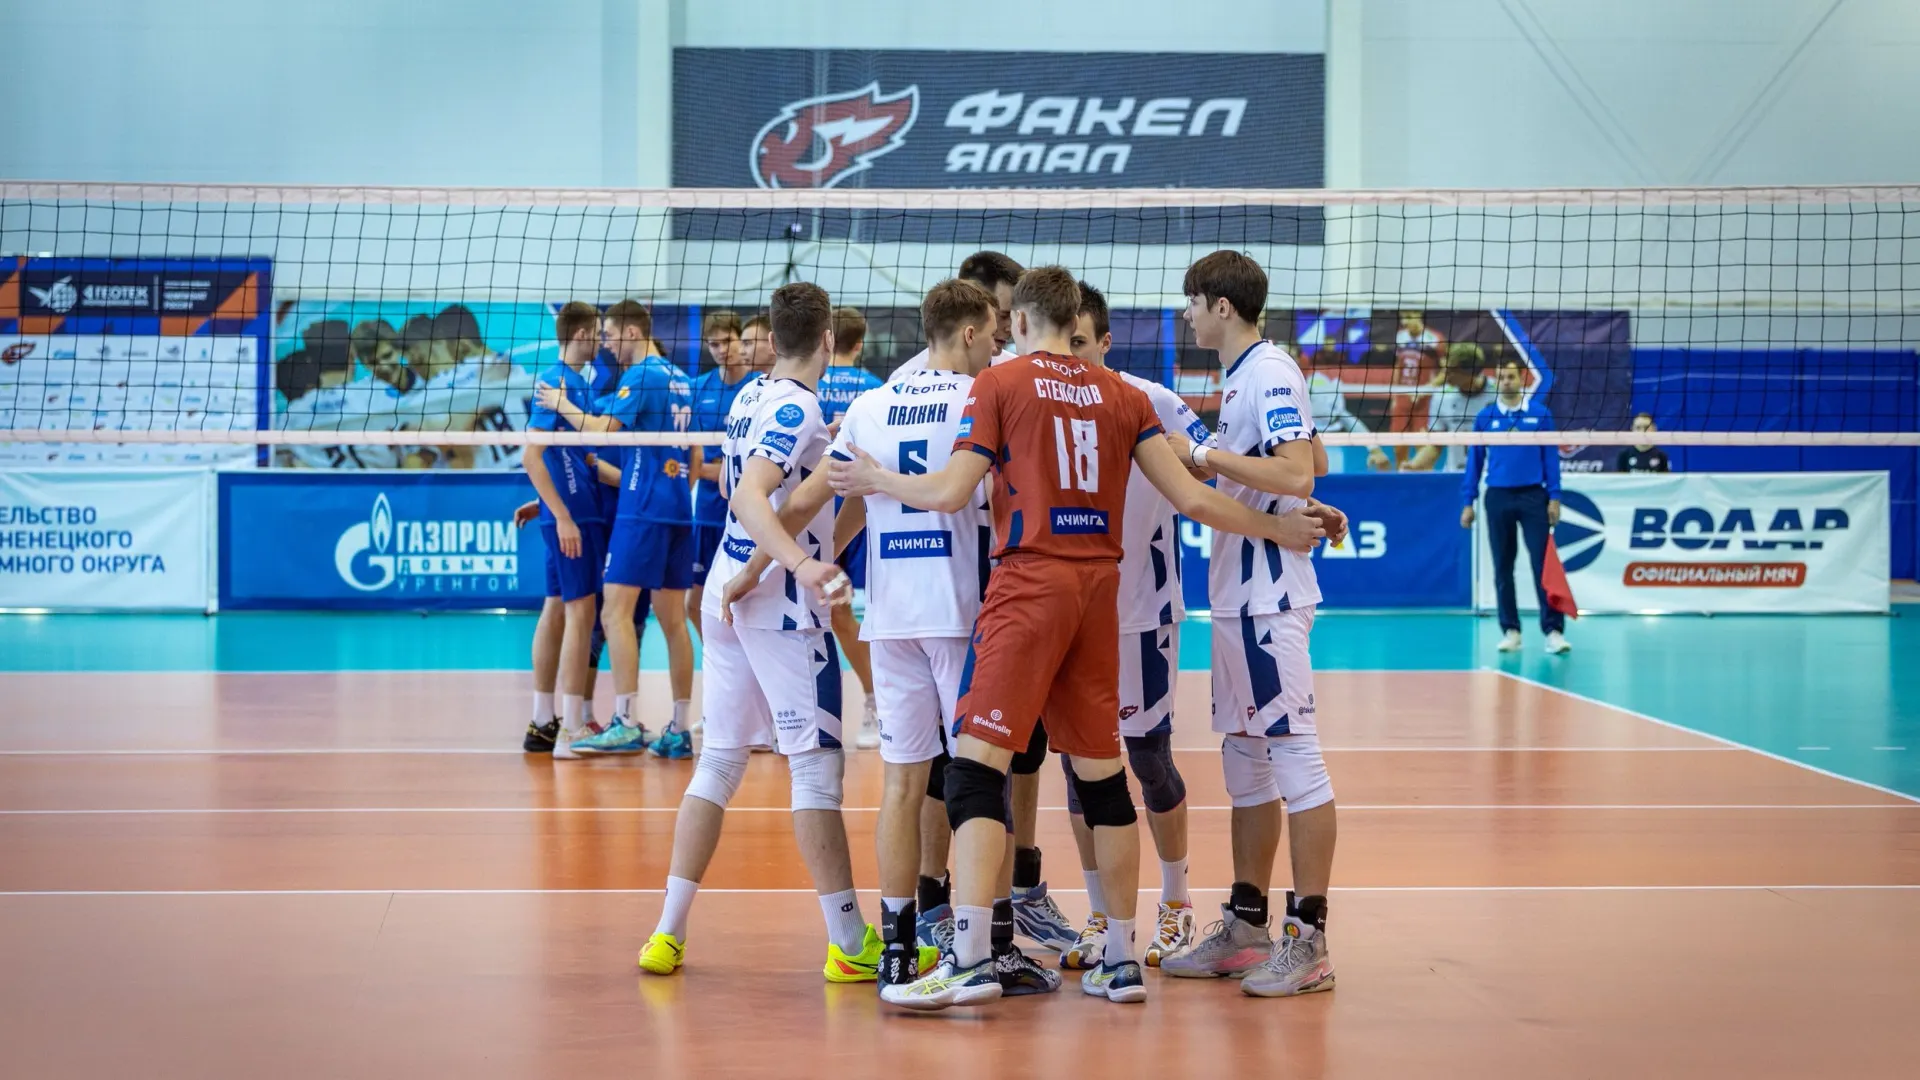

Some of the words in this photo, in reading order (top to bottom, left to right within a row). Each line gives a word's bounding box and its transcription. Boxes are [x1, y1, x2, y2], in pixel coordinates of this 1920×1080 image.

[944, 89, 1247, 136] ФАКЕЛ
[945, 142, 1131, 173] ЯМАЛ
[1045, 360, 1088, 378] ГЕОТЕК
[905, 383, 958, 395] ГЕОТЕК
[1034, 377, 1103, 407] СТЕПАНОВ
[1272, 387, 1292, 397] ВФВ
[887, 403, 948, 425] ПАЛКИН
[1053, 415, 1099, 493] 18
[0, 506, 97, 525] ЕЛЬСТВО
[396, 521, 518, 553] ГАЗПРОМ
[1629, 507, 1849, 550] ВОЛАР
[0, 530, 133, 551] НЕНЕЦКОГО
[888, 538, 945, 551] АЧИМГАЗ
[0, 555, 74, 573] МНОГО
[82, 555, 165, 573] ОКРУГА
[401, 557, 514, 575] ДОБЫЧА
[1632, 564, 1760, 583] ОФИЦИАЛЬНЫЙ
[1763, 567, 1798, 582] МЯЧ
[398, 576, 519, 592] УРЕНГОЙ
[973, 714, 1013, 737] @fakelvolley
